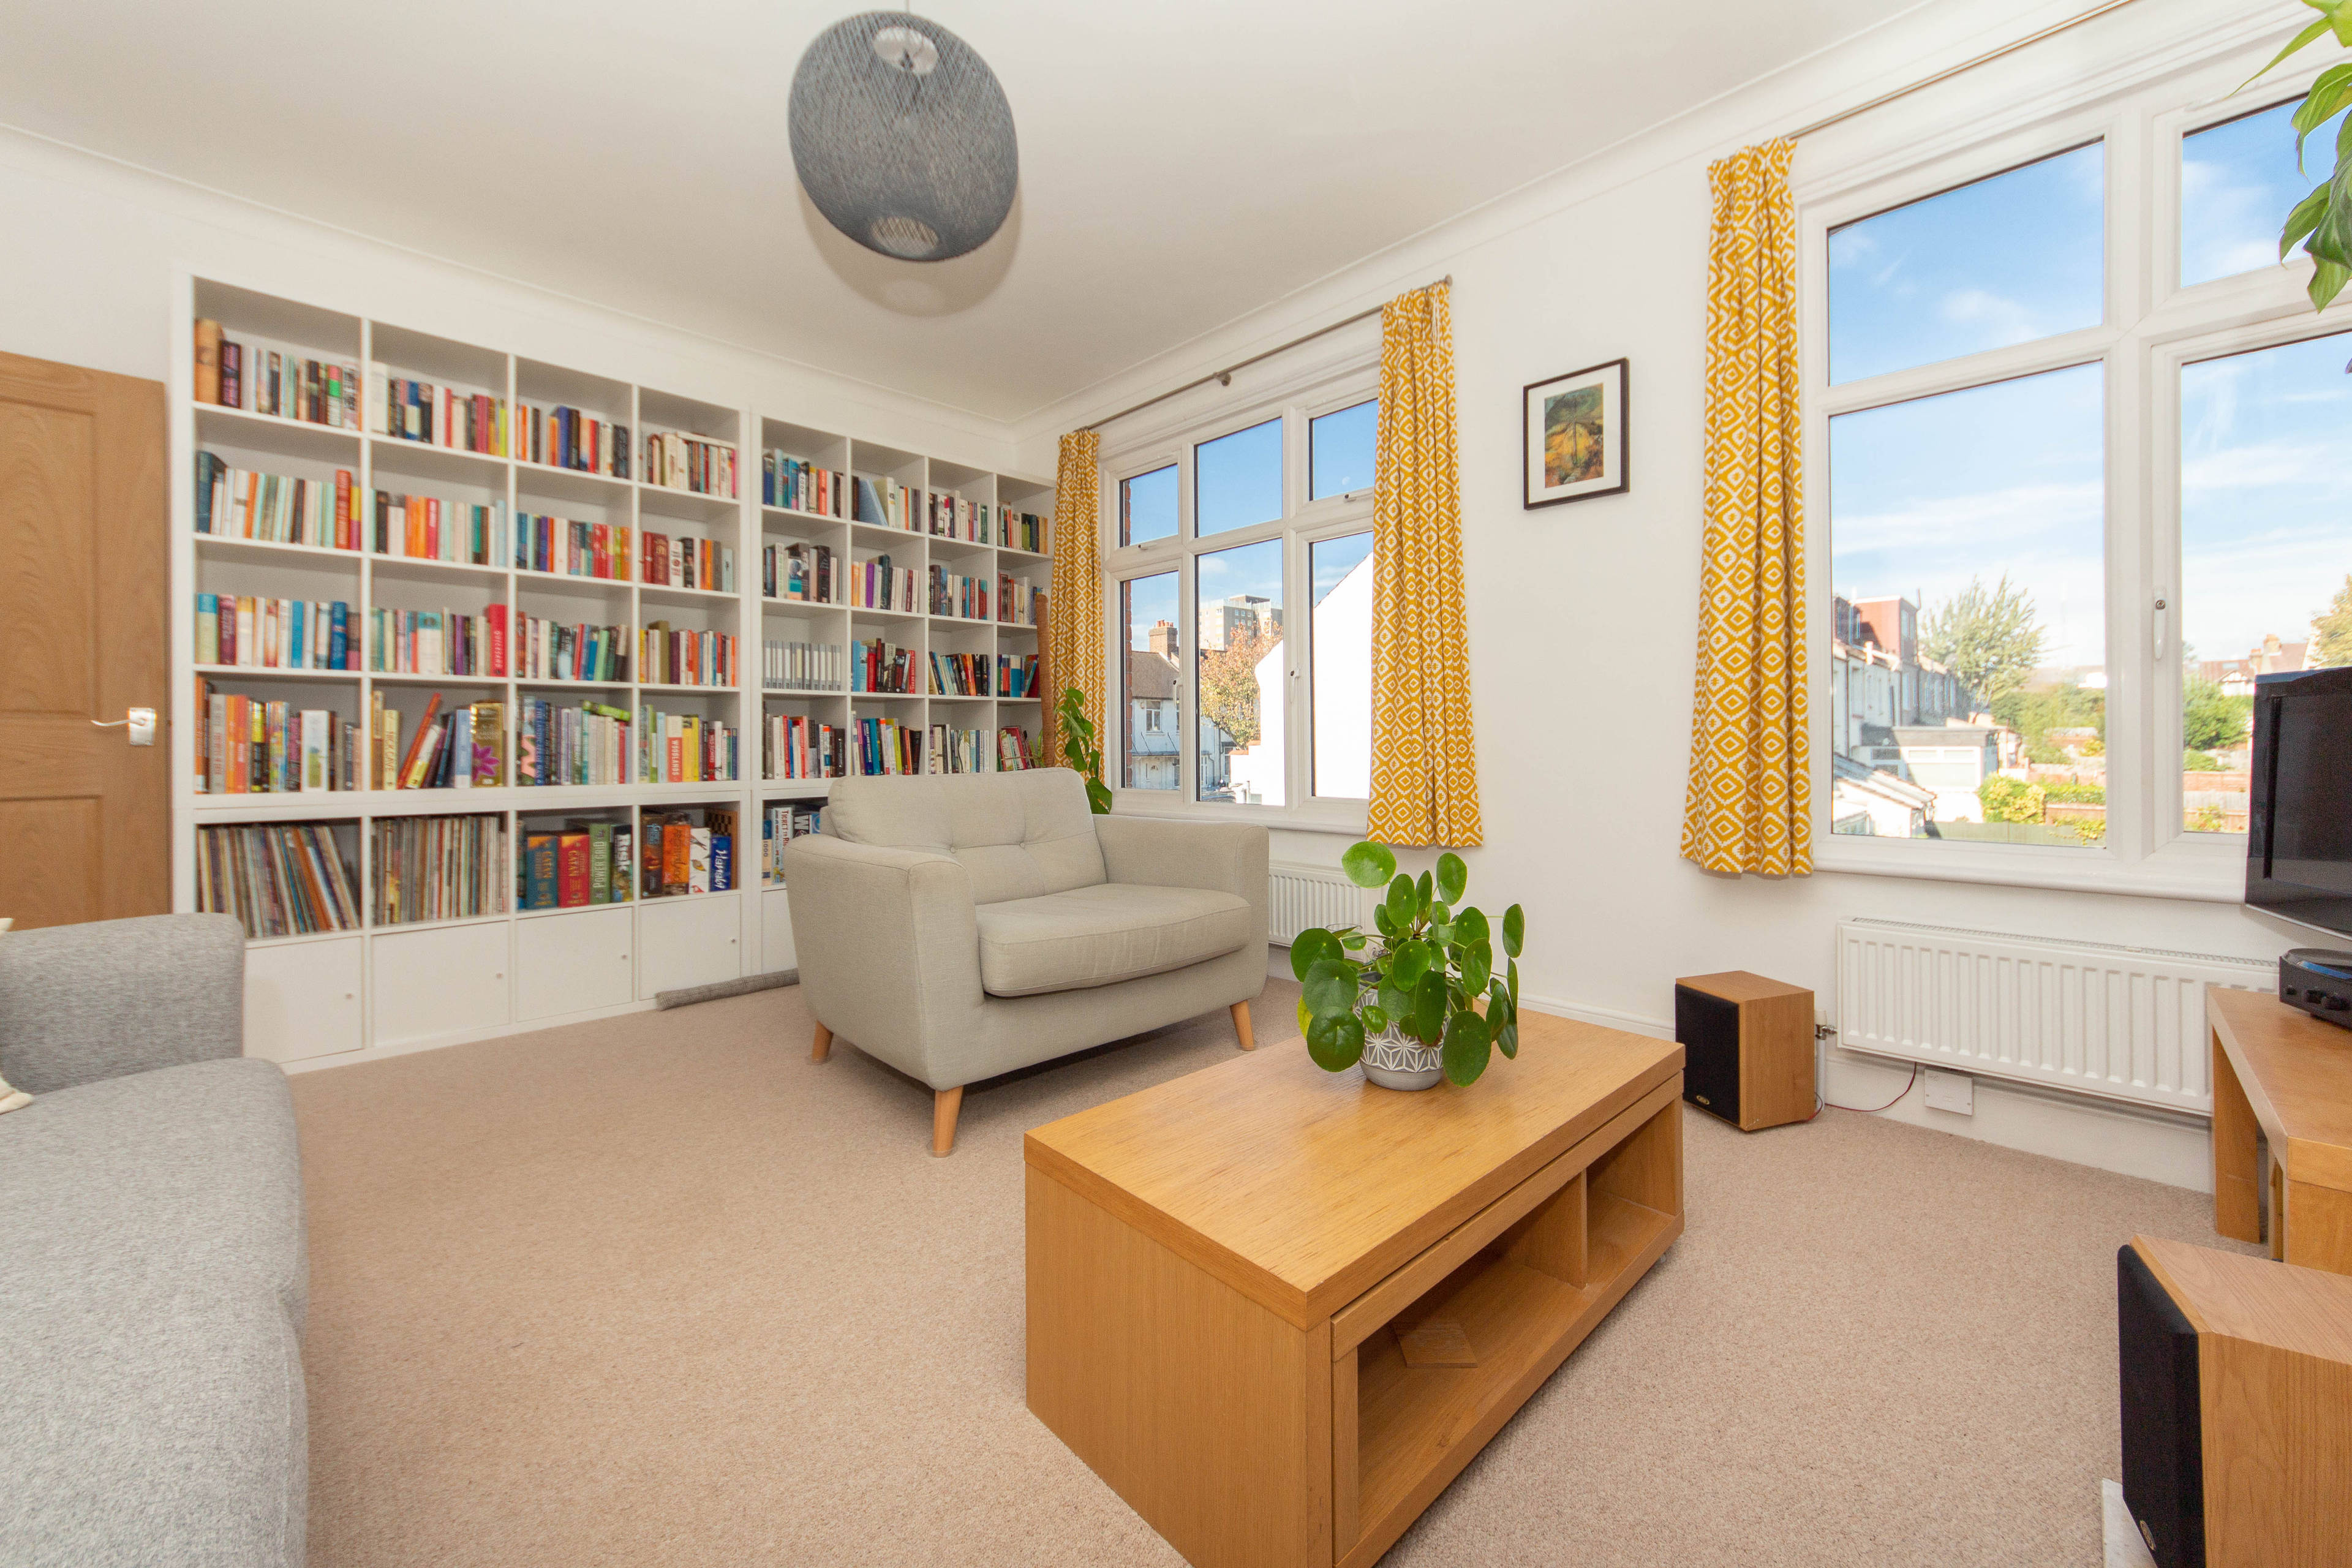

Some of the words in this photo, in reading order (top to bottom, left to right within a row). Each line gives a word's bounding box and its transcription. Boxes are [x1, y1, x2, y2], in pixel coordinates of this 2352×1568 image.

[385, 730, 394, 750] NICK
[385, 751, 394, 772] CAVE
[671, 739, 680, 776] WOODLANDS
[781, 810, 790, 831] TICKET
[592, 841, 606, 859] GRID
[542, 851, 553, 879] CATAN
[568, 850, 579, 877] CATAN
[592, 861, 606, 888] POWER
